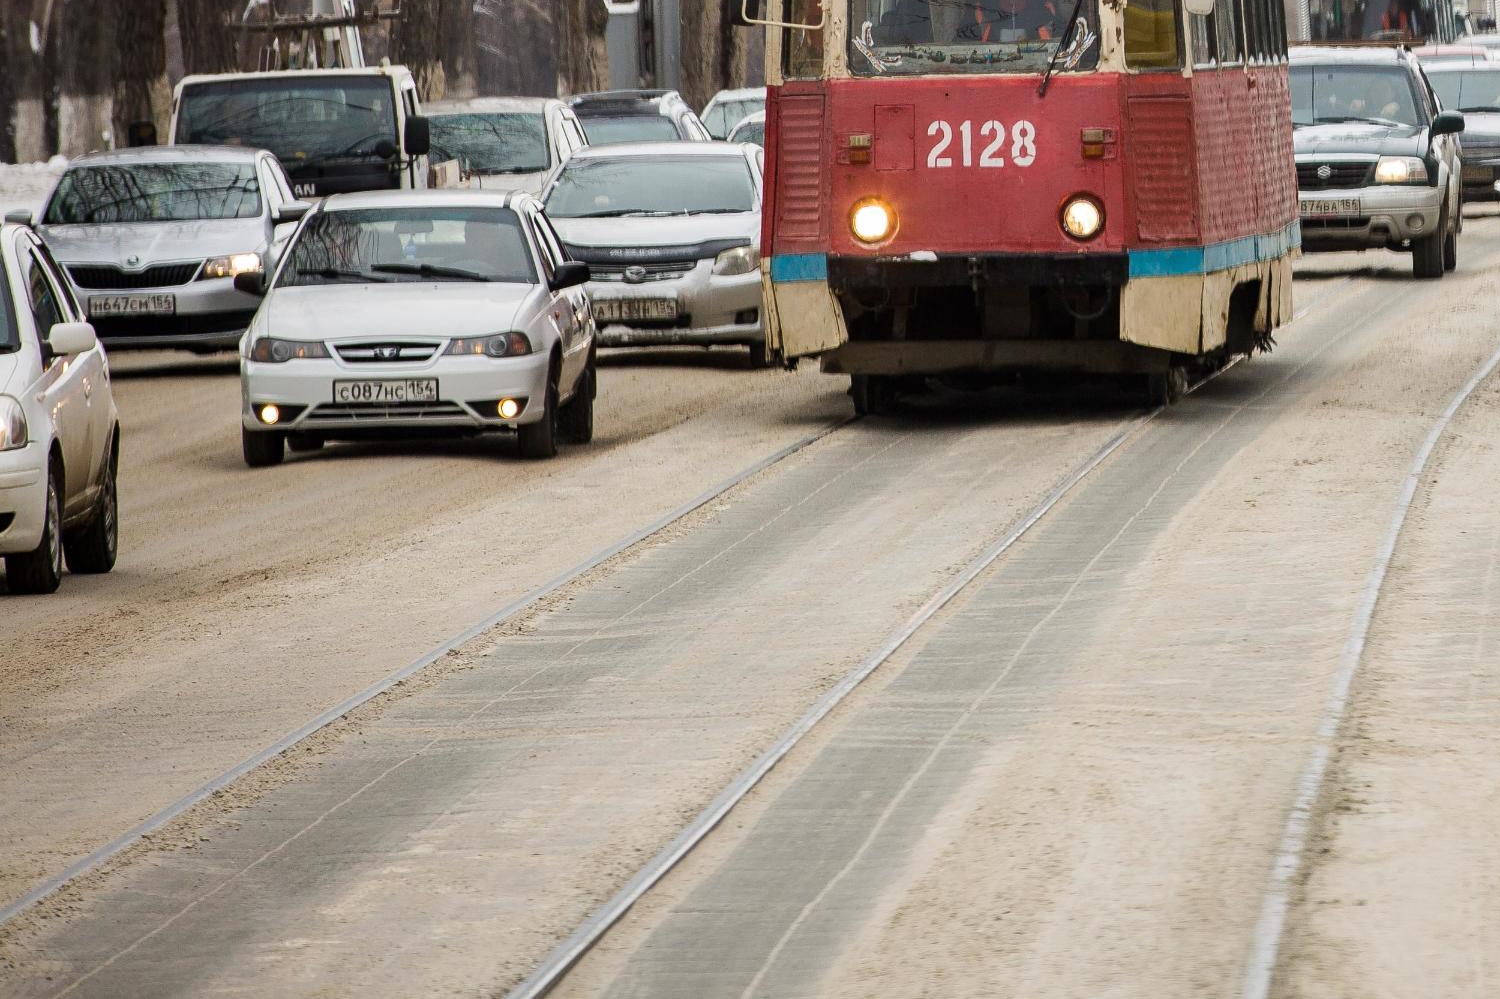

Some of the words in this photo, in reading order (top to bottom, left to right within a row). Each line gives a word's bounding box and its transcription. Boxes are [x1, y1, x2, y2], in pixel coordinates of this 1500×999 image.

[927, 119, 1037, 168] 2128
[340, 382, 404, 401] С087НС
[408, 380, 433, 396] 154
